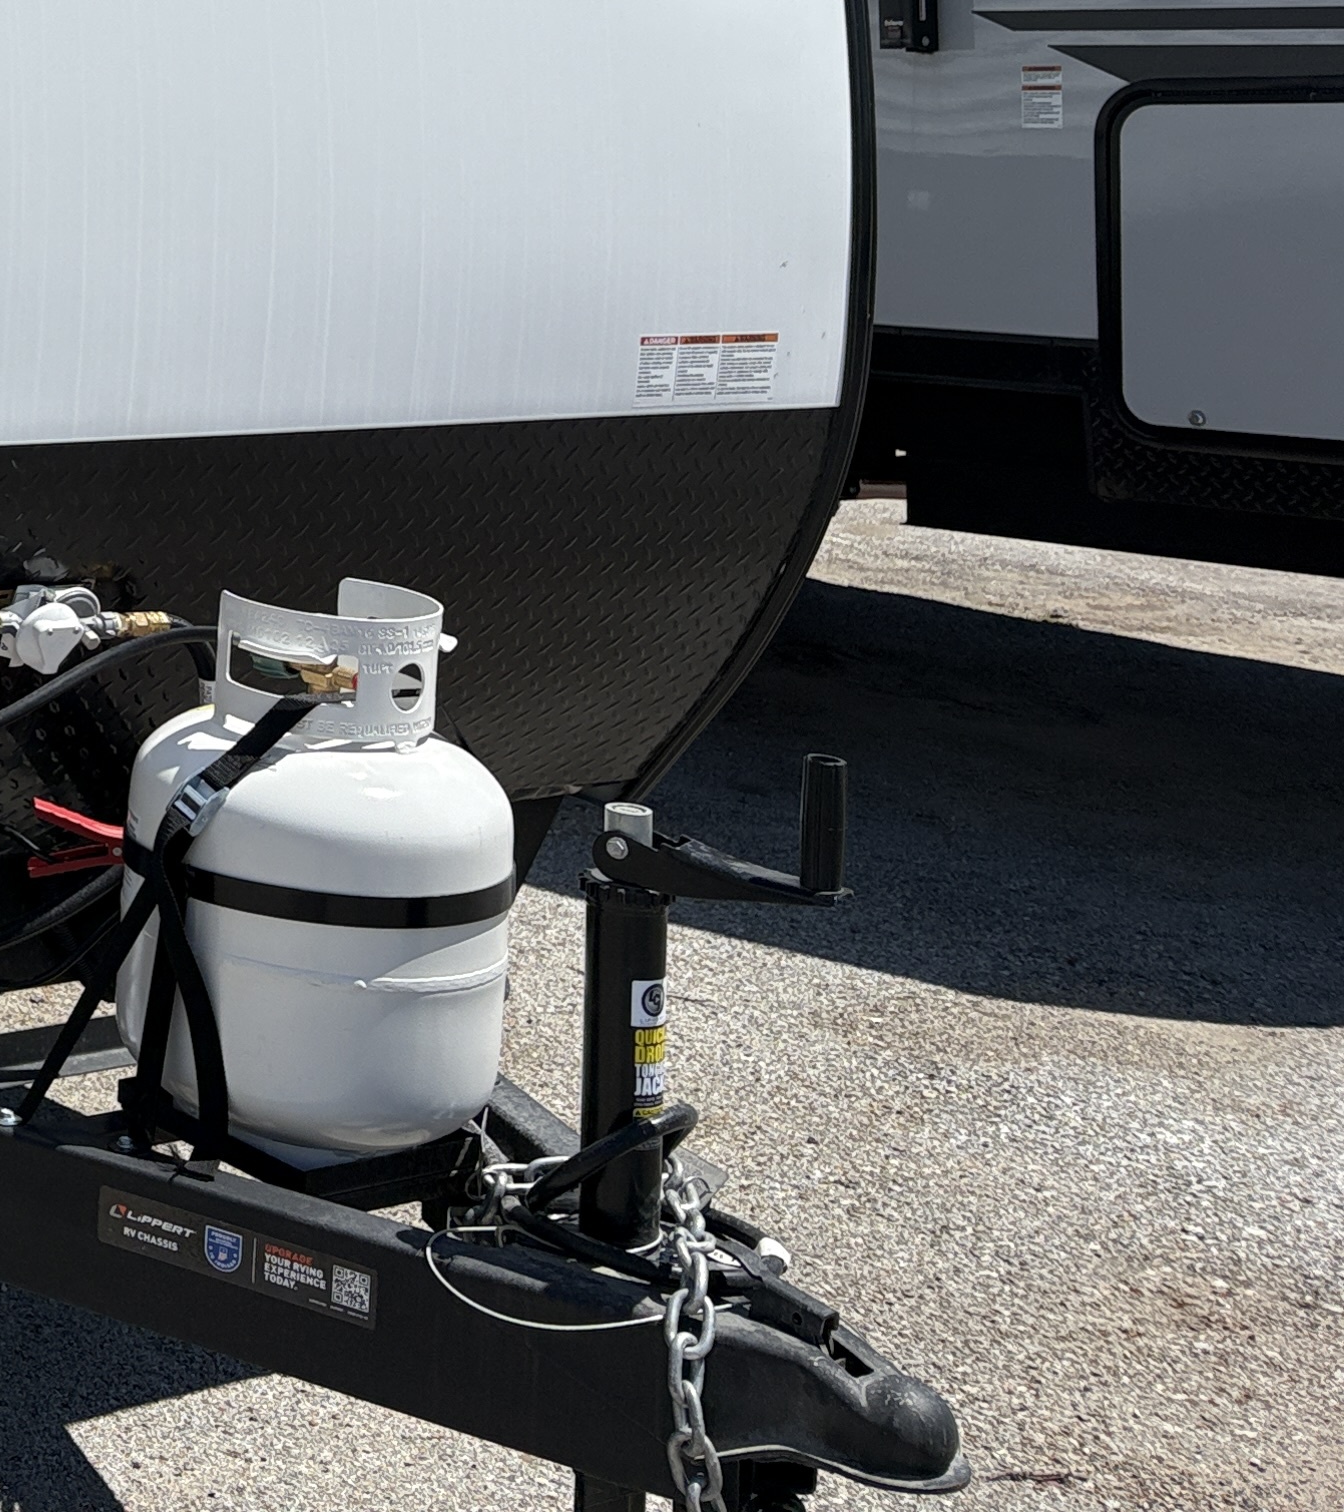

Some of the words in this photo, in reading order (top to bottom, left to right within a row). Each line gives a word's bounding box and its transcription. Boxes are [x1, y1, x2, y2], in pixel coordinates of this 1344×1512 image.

[123, 1226, 136, 1238] RV
[137, 1230, 179, 1251] CHASSIS
[264, 1243, 314, 1265] UPGRADE
[264, 1252, 291, 1268] YOUR
[292, 1261, 324, 1279] RVING
[263, 1262, 327, 1290] EXPERIENCE
[263, 1271, 298, 1291] TODAY.
